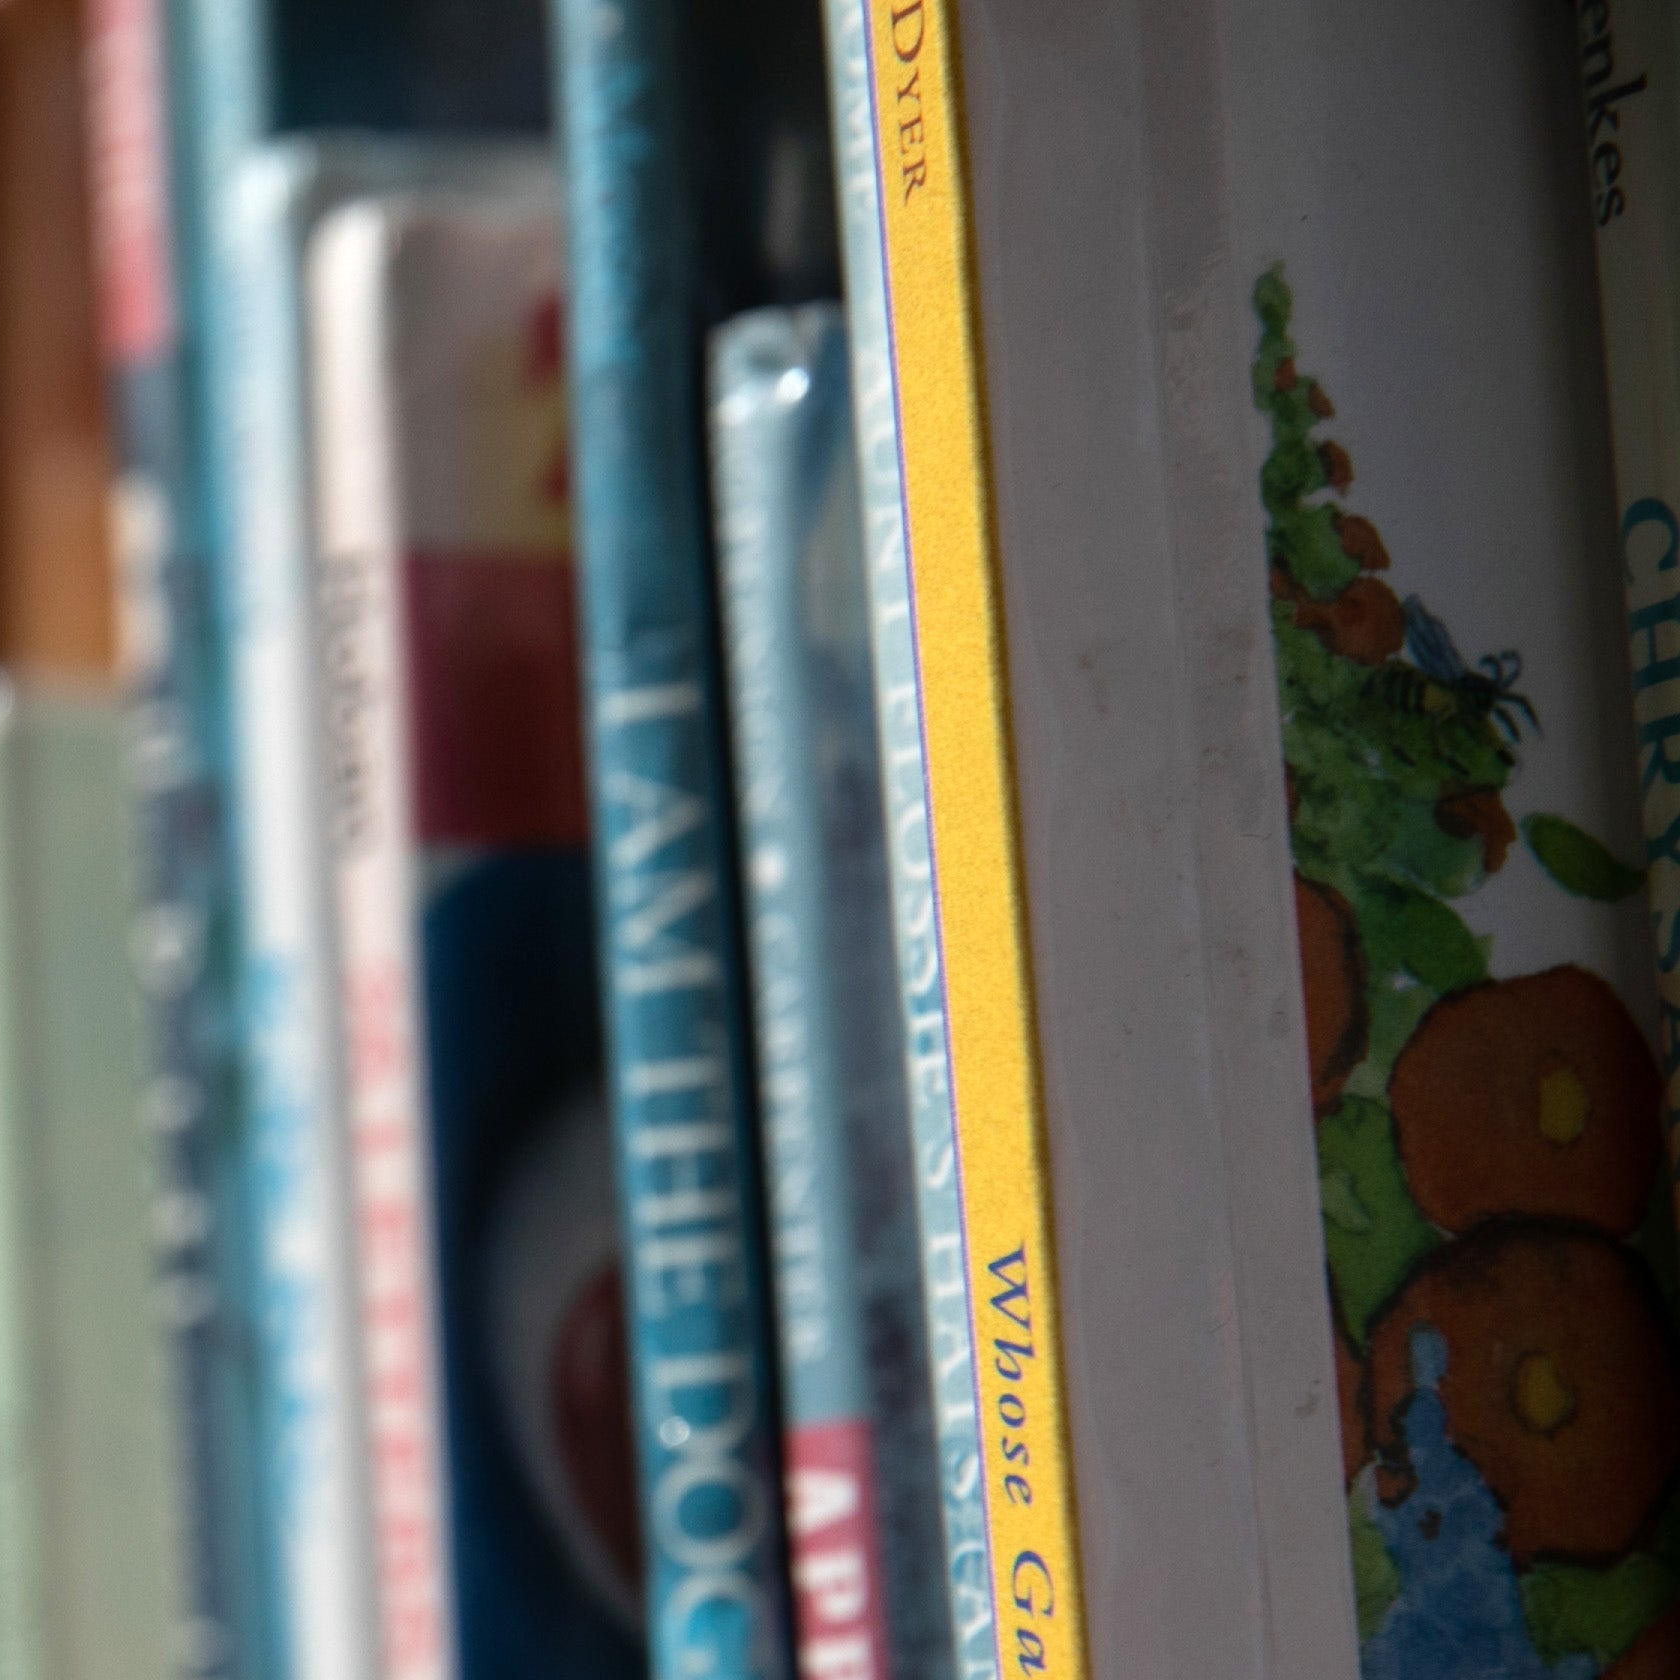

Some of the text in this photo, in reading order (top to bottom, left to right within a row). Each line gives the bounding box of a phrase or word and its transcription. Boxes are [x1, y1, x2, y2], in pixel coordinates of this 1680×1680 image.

[891, 0, 928, 206] DYER
[606, 768, 720, 994] AM
[623, 1022, 746, 1318] THE
[987, 1238, 1035, 1506] Whose
